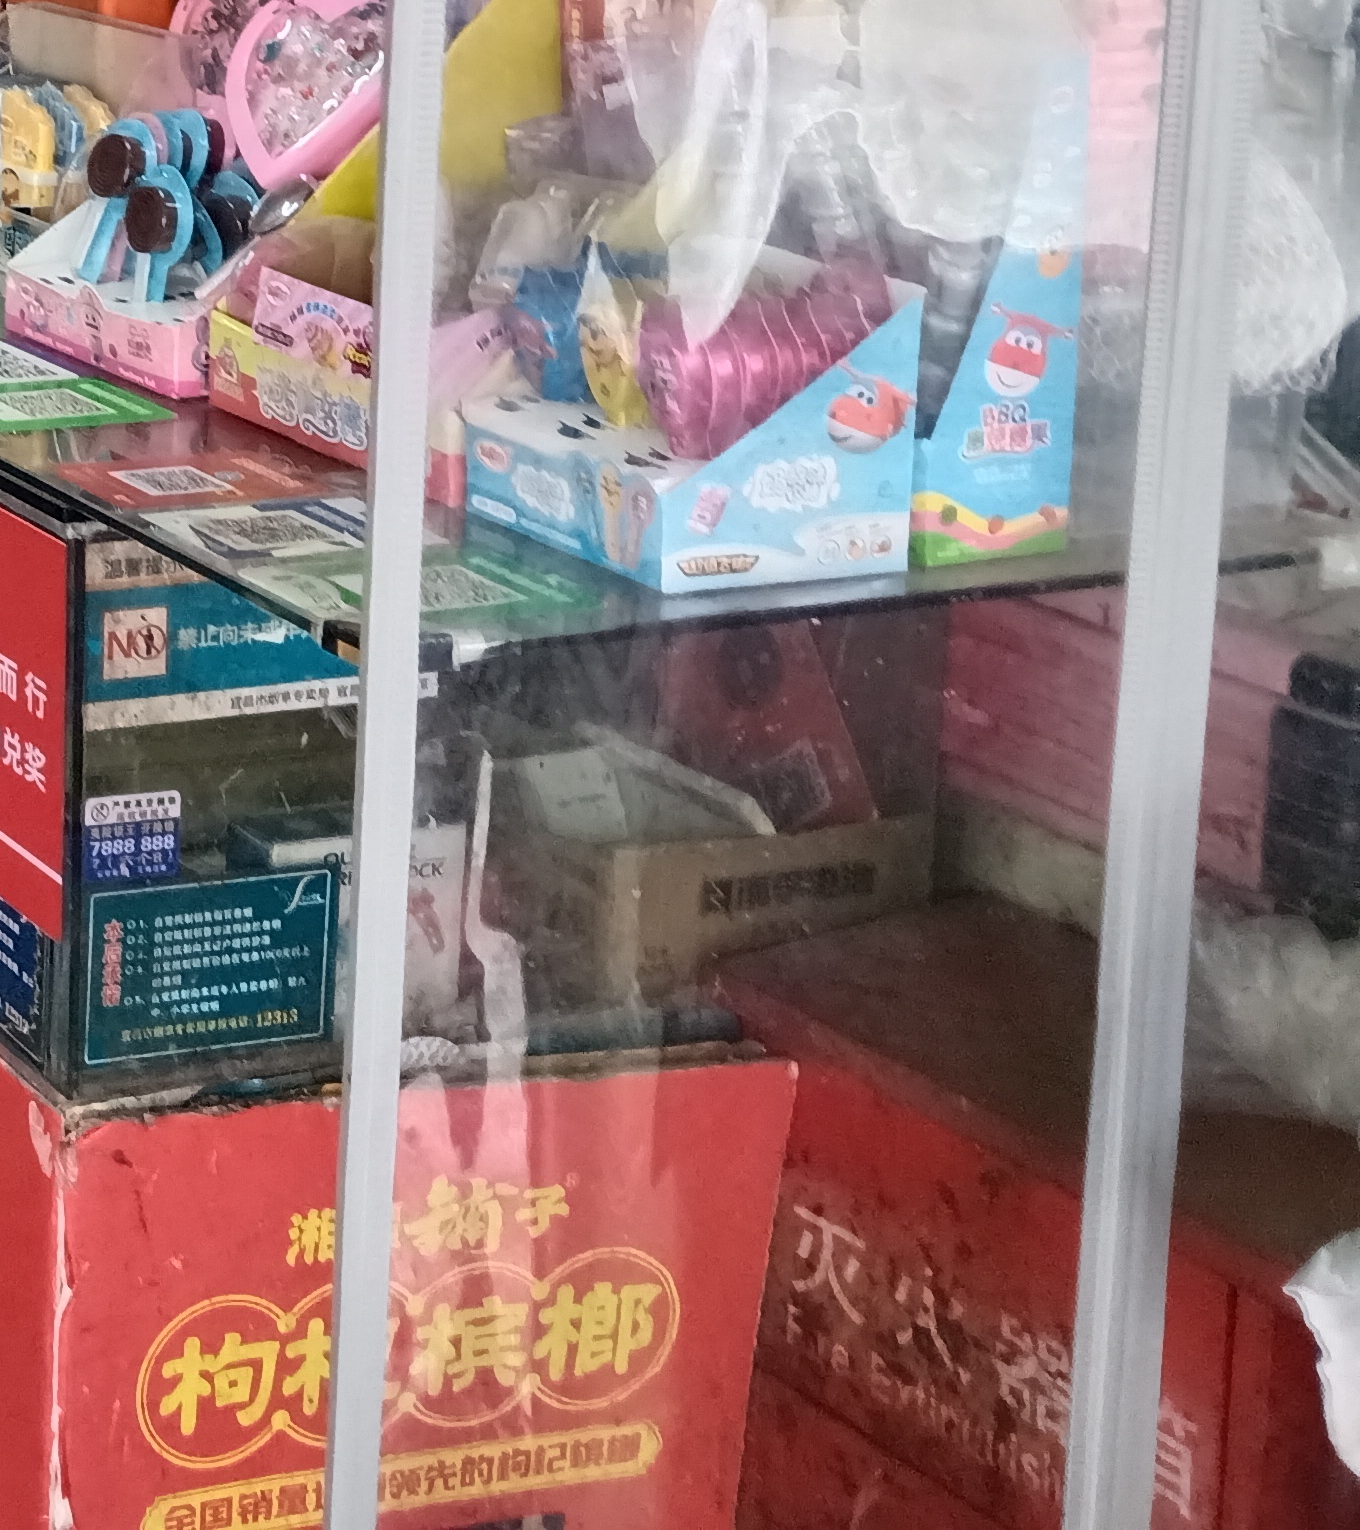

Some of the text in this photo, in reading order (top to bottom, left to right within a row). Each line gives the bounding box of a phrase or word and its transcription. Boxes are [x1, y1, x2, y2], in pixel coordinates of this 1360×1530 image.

[90, 834, 175, 857] 7888 888
[287, 1174, 571, 1269] 湘铺子
[160, 1280, 663, 1436] 枸槟榔
[165, 1430, 642, 1530] 全国销量领先的枸杞槟榔
